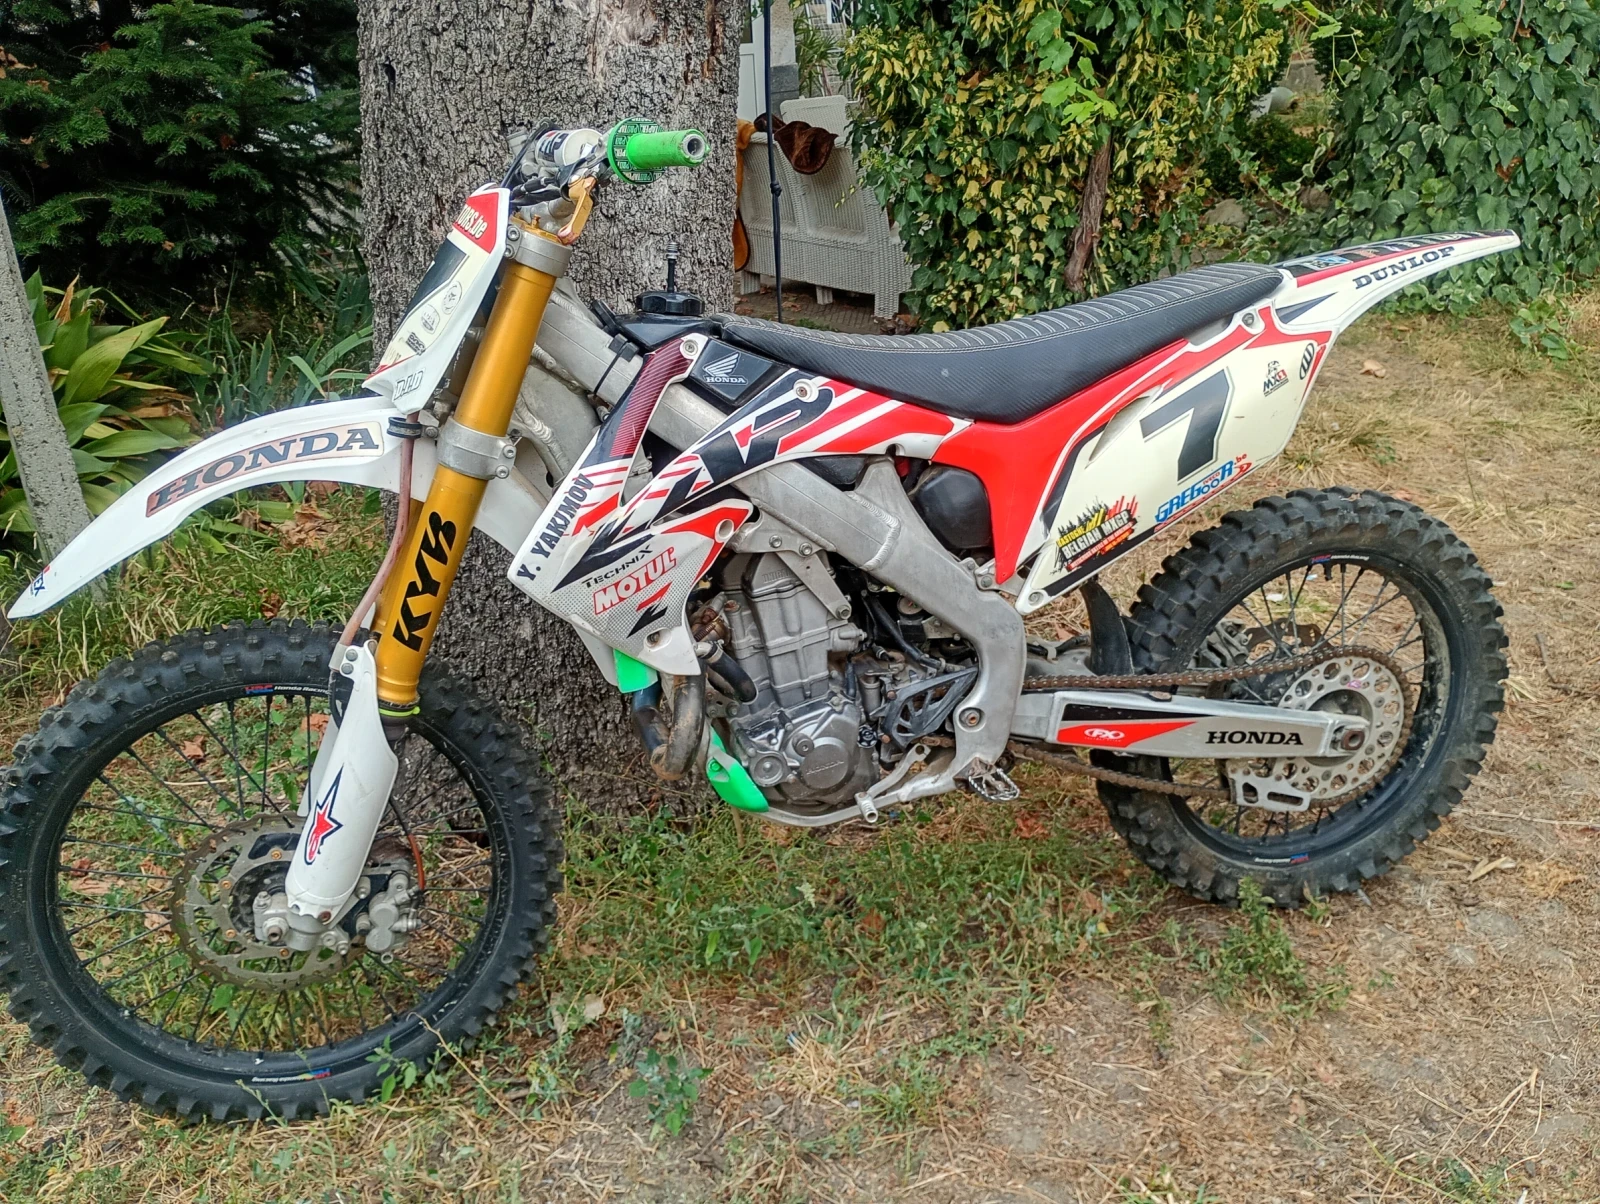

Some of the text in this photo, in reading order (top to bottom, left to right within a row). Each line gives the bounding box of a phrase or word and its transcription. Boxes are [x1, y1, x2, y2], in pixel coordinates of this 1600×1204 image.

[1353, 246, 1455, 289] DUNLOP
[1139, 367, 1233, 485] 7
[152, 428, 380, 510] HONDA
[516, 473, 595, 581] Y. YAKIMOV
[1061, 526, 1103, 559] BELGIAN
[1101, 510, 1130, 536] MXGP
[392, 511, 457, 652] KYB
[581, 544, 653, 589] TECHNIX
[593, 546, 677, 615] MOTUL
[245, 684, 273, 694] HRC
[1204, 730, 1303, 746] HONDA
